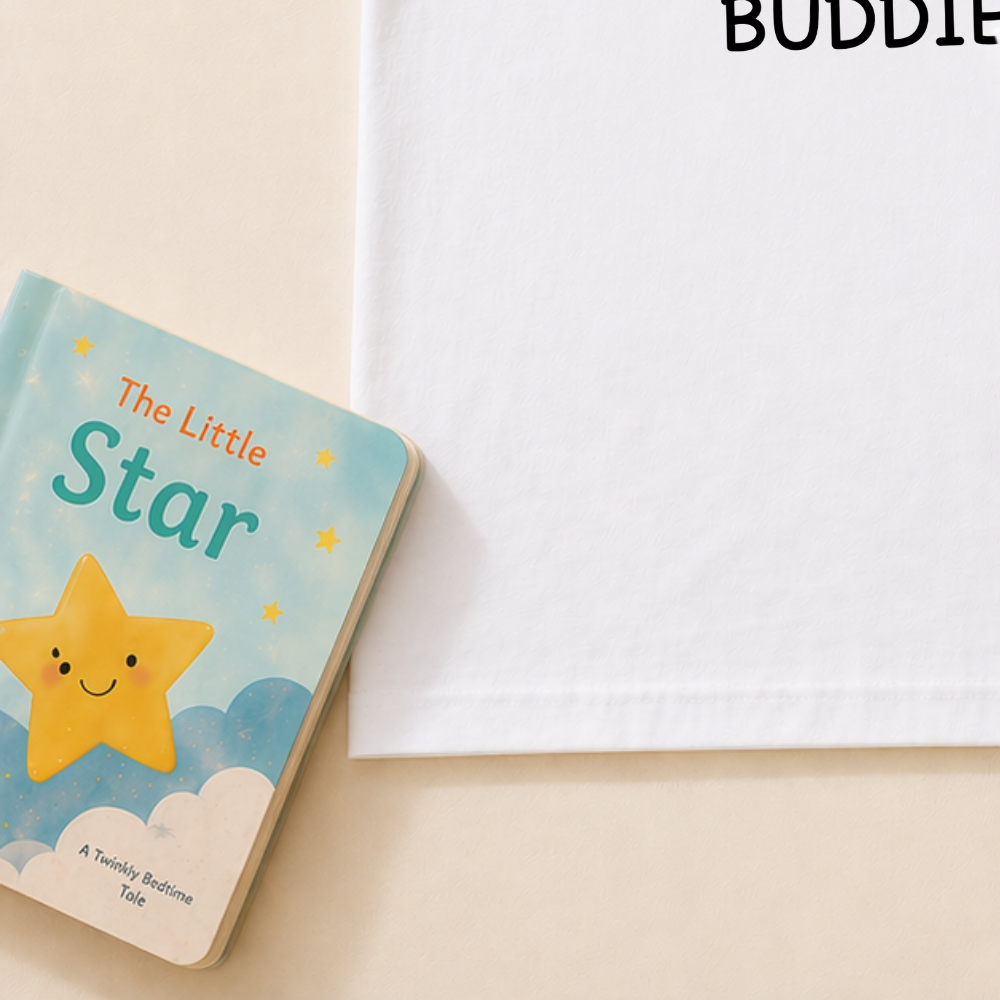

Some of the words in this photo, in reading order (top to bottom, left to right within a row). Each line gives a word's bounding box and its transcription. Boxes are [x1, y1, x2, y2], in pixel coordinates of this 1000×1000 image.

[118, 376, 172, 425] The
[179, 405, 267, 467] Little
[52, 420, 259, 560] Star
[78, 844, 90, 858] A
[93, 848, 140, 881] Twinkly
[141, 871, 194, 905] Bedtime
